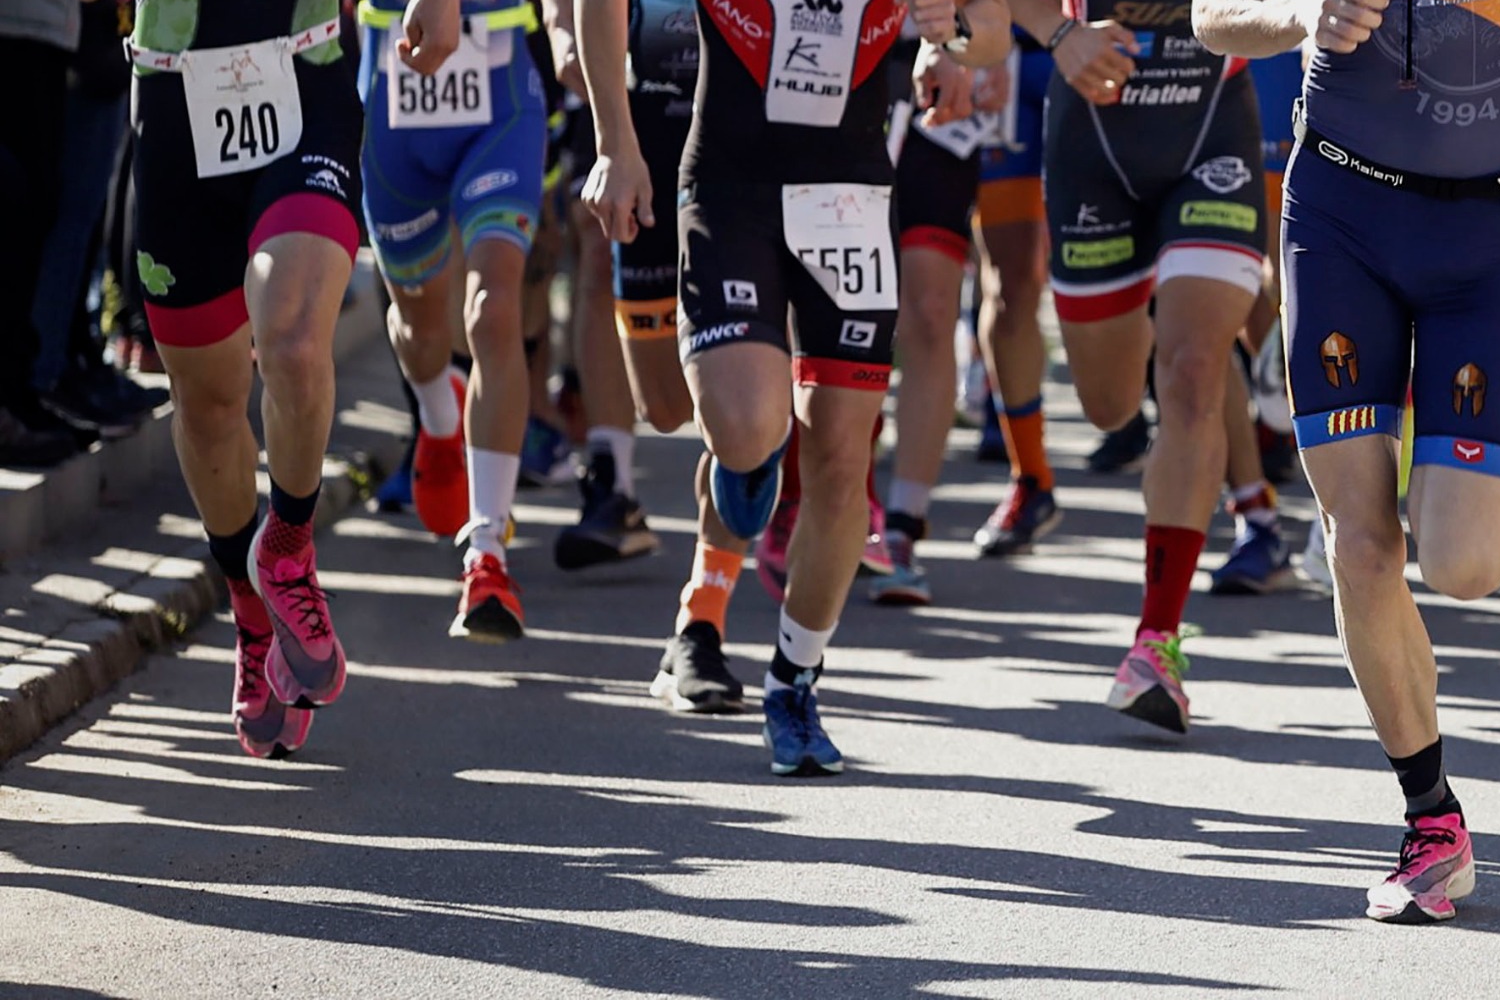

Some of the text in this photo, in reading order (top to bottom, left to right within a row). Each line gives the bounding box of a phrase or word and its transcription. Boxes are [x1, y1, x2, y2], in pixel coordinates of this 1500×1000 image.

[398, 68, 481, 115] 5846
[773, 77, 843, 97] HUUB
[1415, 87, 1500, 128] 1994
[214, 101, 281, 164] 240
[1349, 157, 1404, 186] Kalenji
